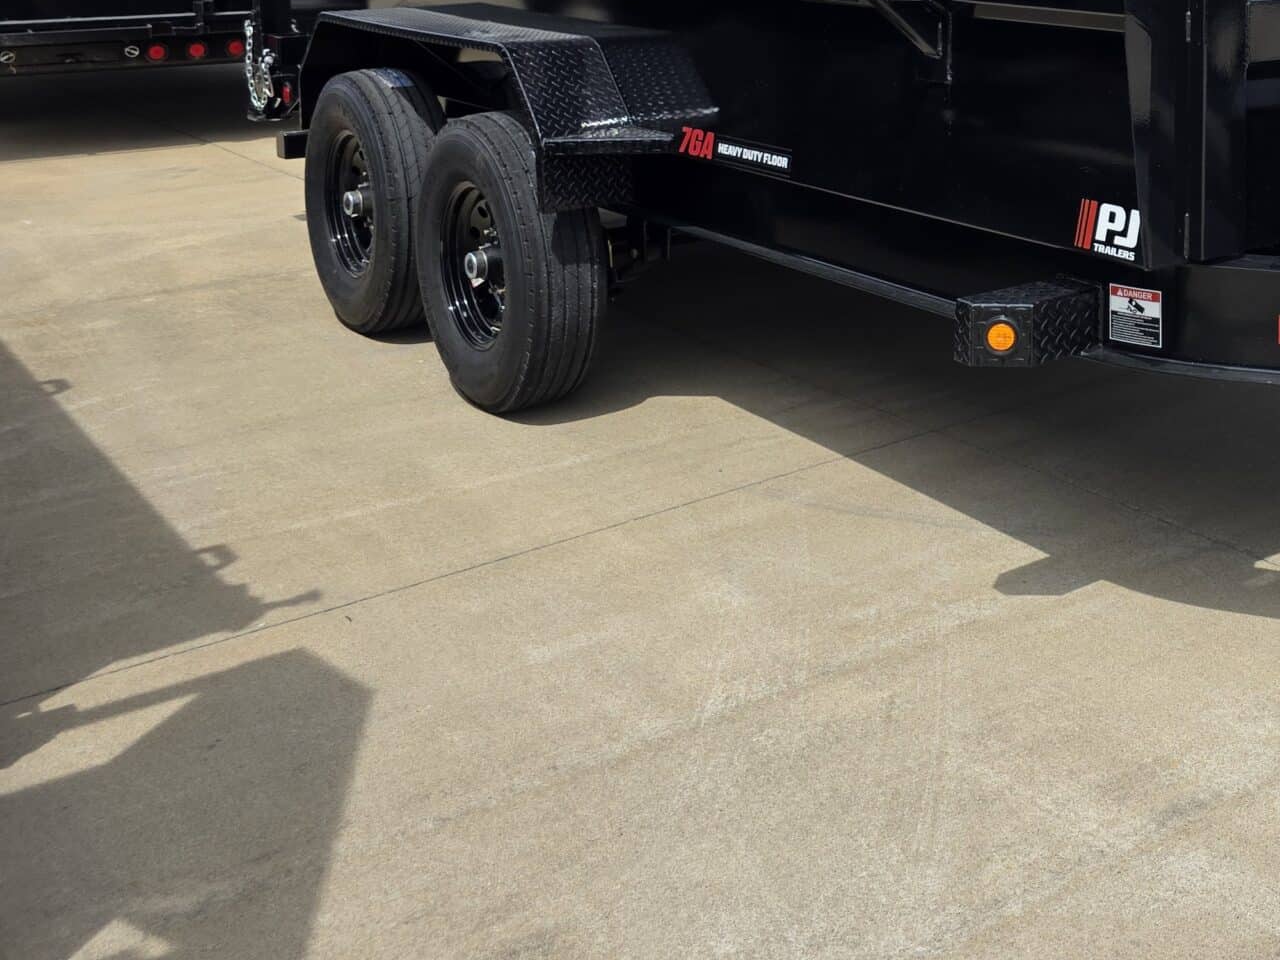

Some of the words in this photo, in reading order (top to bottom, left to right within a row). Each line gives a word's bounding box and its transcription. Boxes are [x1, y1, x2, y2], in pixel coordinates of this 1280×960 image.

[679, 126, 715, 160] 7GA
[717, 142, 743, 158] HEAVY
[742, 148, 763, 162] DUTY
[763, 153, 788, 169] FLOOR
[1095, 202, 1141, 249] PJ
[1093, 242, 1136, 261] TRAILERS
[1123, 288, 1153, 300] DANGER
